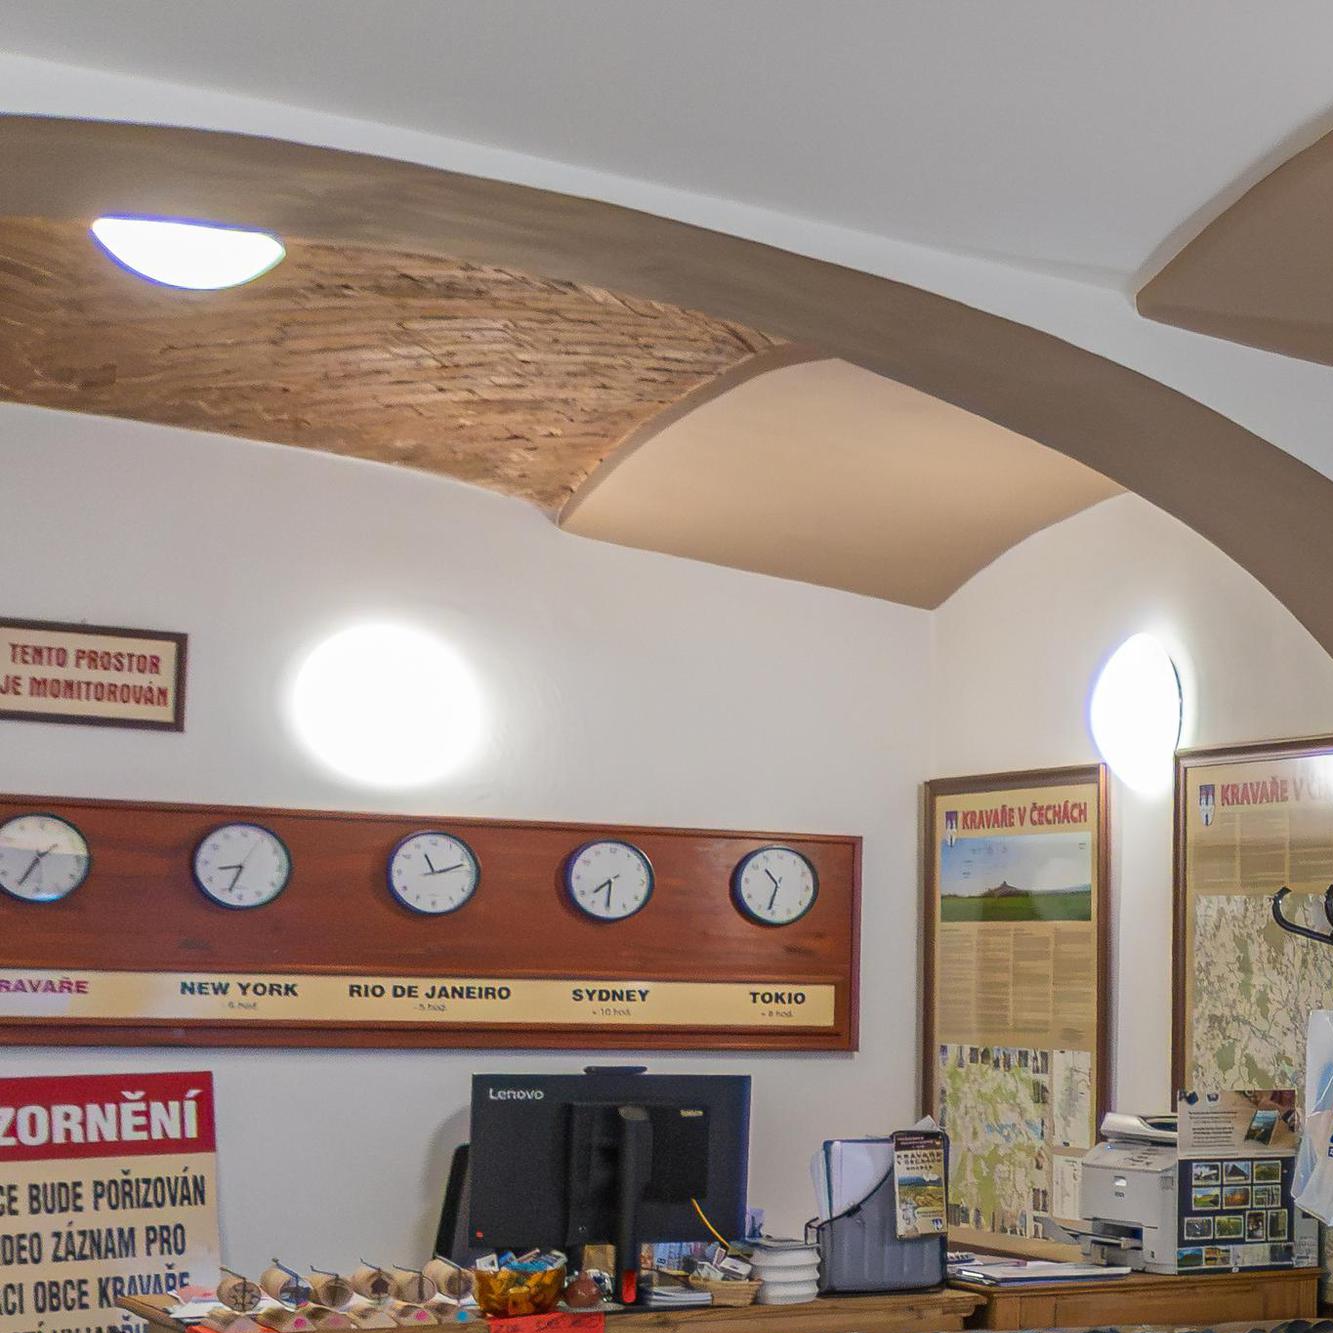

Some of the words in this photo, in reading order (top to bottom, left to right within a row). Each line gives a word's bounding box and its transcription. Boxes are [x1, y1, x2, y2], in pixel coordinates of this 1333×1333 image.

[9, 642, 67, 668] TENTO
[75, 648, 161, 675] PROSTOR
[0, 675, 22, 696] JE
[29, 676, 169, 708] MONITOROVÁN
[1220, 776, 1289, 807] KRAVAŘE
[961, 804, 1015, 830] KRAVAŘE
[1017, 806, 1027, 827] V
[1029, 800, 1088, 826] ČECHÁCH
[180, 980, 231, 996] NEW
[237, 981, 299, 997] YORK
[349, 983, 386, 998] RIO
[392, 984, 420, 999] DE
[424, 985, 512, 1001] JANEIRO
[571, 988, 650, 1003] SYDNEY
[749, 991, 807, 1006] TOKIO
[488, 1087, 545, 1101] Lenovo
[0, 1089, 204, 1146] ZORNĚNÍ
[28, 1181, 85, 1215] BUDE
[92, 1166, 207, 1212] POŘIZOVÁN
[51, 1220, 137, 1263] ZÁZNAM
[145, 1223, 187, 1257] PRO
[0, 1282, 25, 1316] CI
[34, 1279, 90, 1314] OBCE
